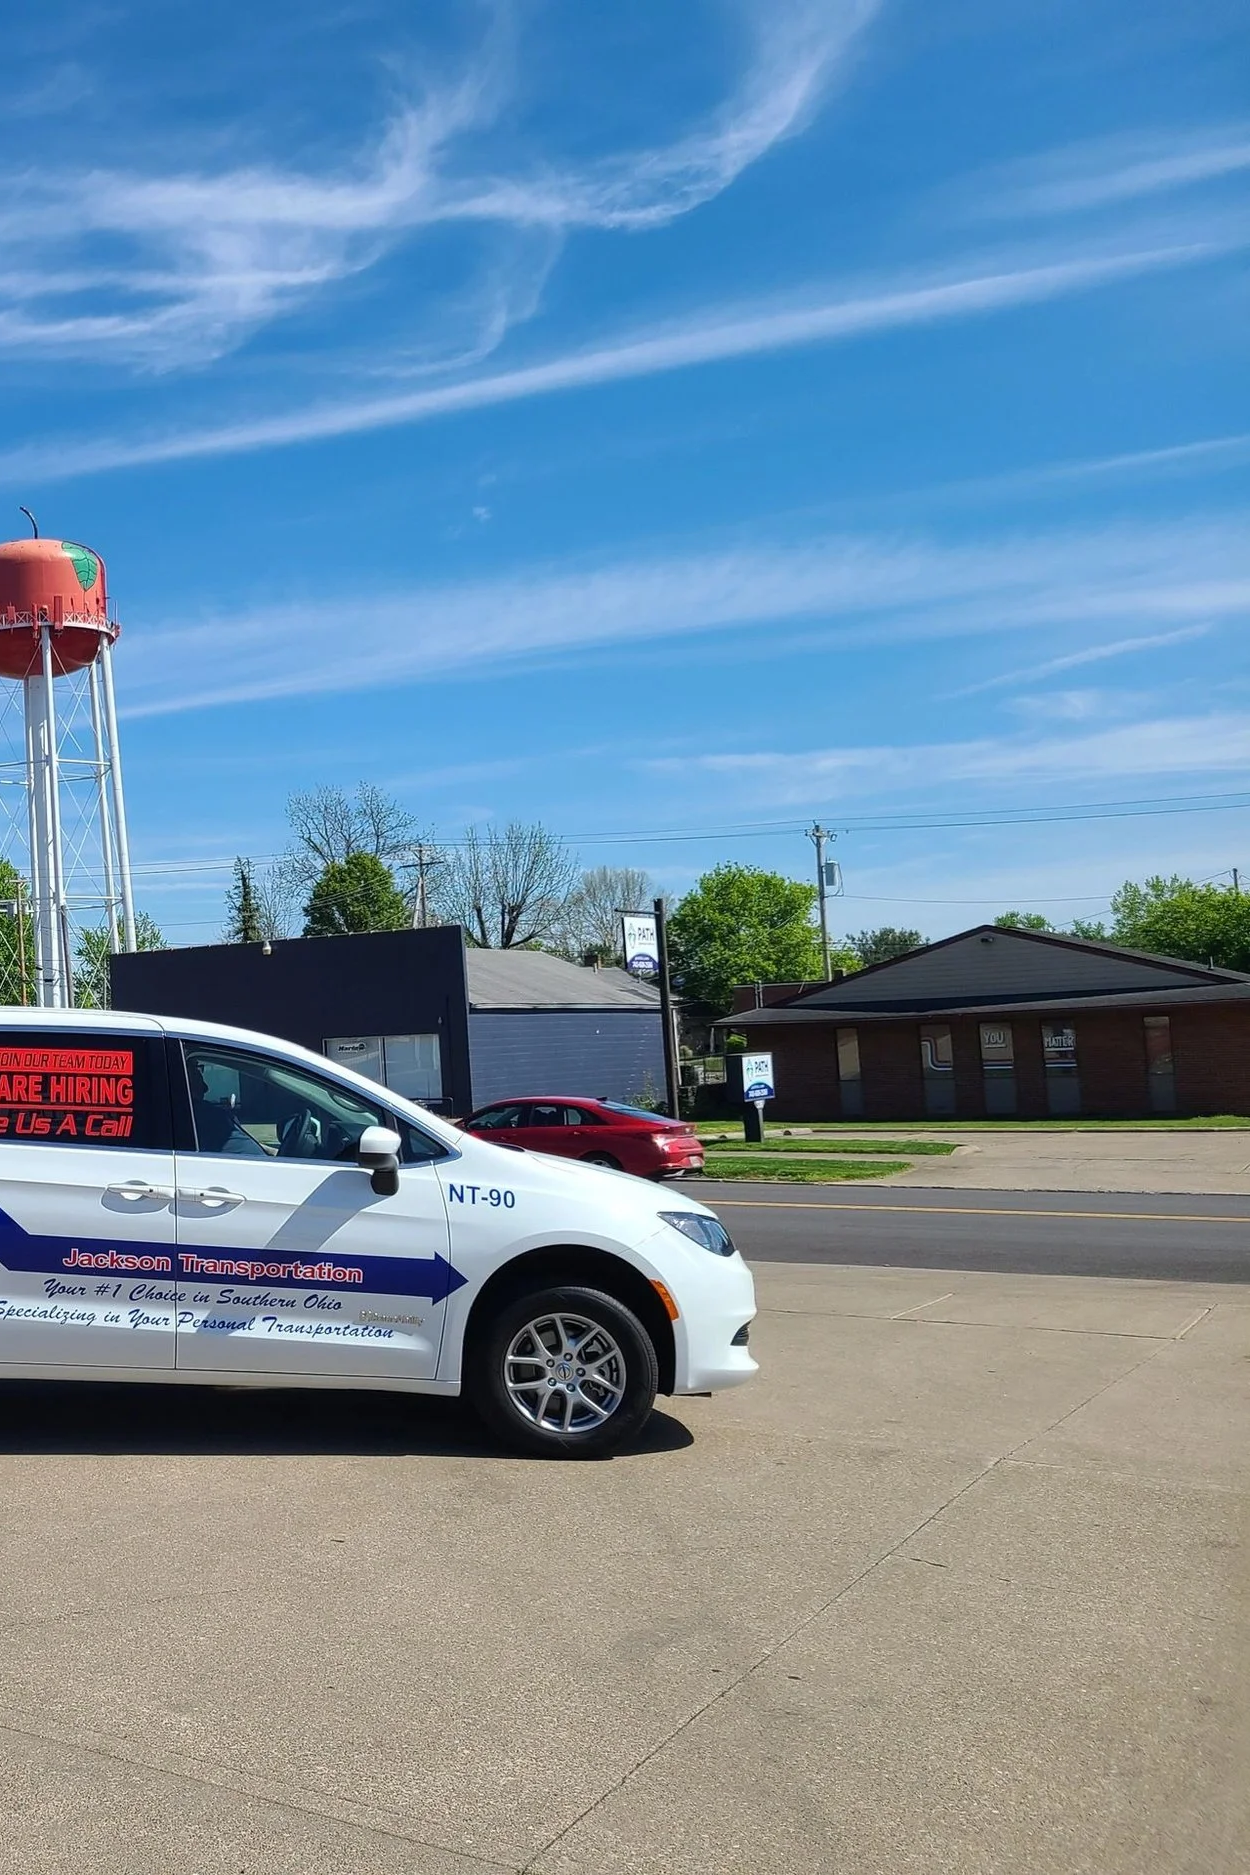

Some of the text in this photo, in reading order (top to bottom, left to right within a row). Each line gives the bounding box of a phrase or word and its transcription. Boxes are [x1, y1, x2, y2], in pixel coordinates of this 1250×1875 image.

[637, 926, 655, 942] PATH
[984, 1031, 1075, 1048] YOU MATTER
[23, 1053, 50, 1068] OUR
[53, 1054, 85, 1069] TEAM
[88, 1055, 128, 1070] TODAY
[50, 1076, 133, 1105] HIRING
[15, 1112, 52, 1135] Us
[55, 1113, 78, 1136] A
[85, 1114, 133, 1137] Call
[449, 1183, 516, 1209] NT-90
[62, 1248, 363, 1284] Jackson Transportation
[43, 1278, 343, 1311] Your #1 Choice in Southern Ohio
[104, 1310, 121, 1323] in
[127, 1308, 171, 1330] Your
[177, 1311, 256, 1332] Personal
[262, 1316, 395, 1339] Transportation
